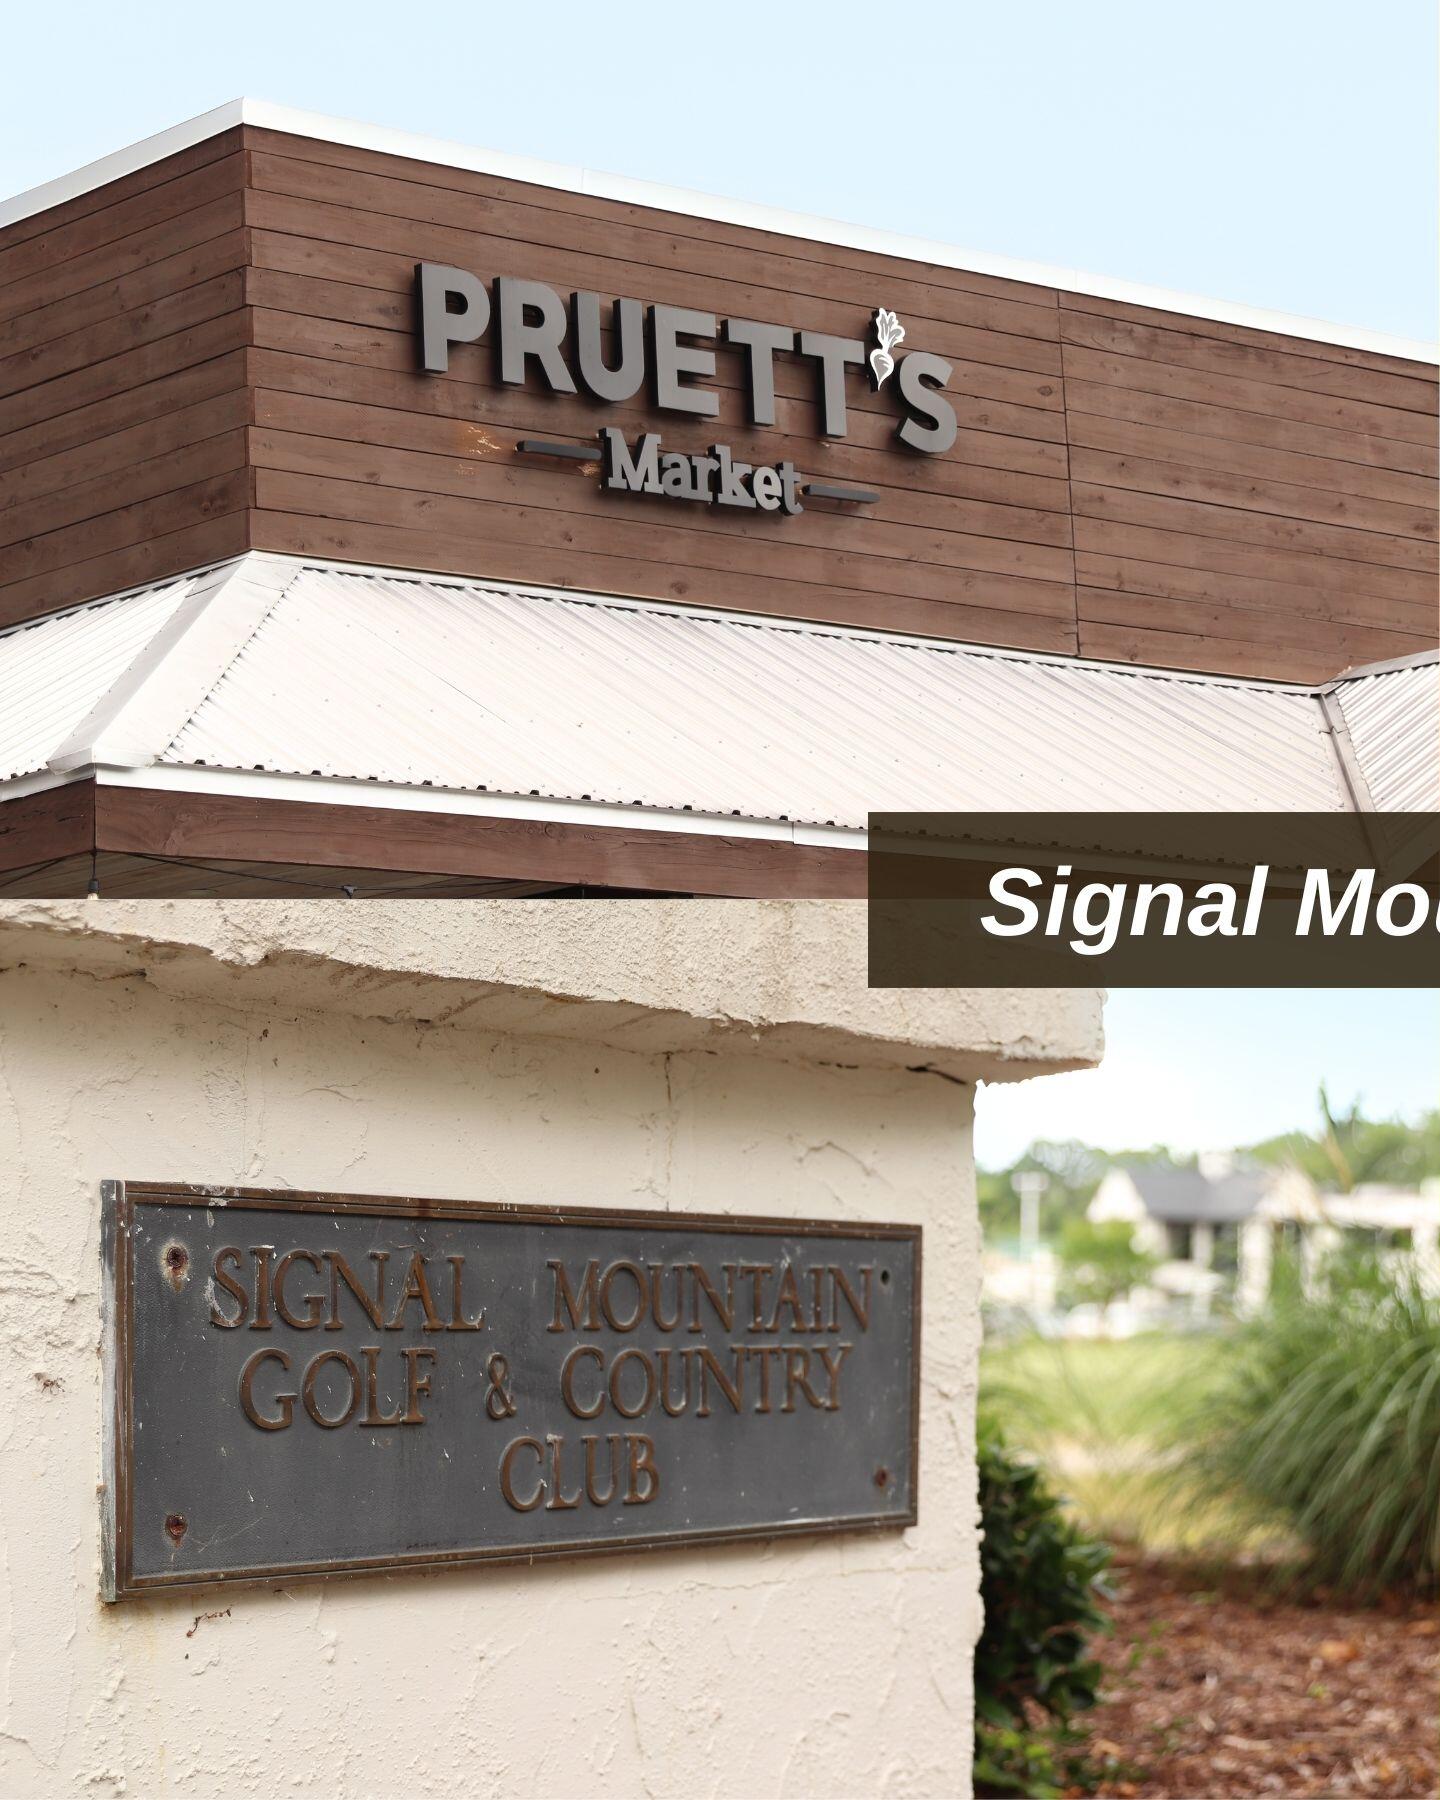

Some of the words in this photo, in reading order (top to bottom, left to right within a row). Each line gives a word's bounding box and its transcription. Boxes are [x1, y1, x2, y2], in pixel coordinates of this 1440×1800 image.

[600, 427, 803, 515] Market
[209, 1245, 486, 1332] SIGNAL
[546, 1258, 874, 1334] MOUNTAIN
[240, 1346, 437, 1431] GOLF
[485, 1352, 517, 1421] &
[560, 1342, 852, 1422] COUNTRY
[499, 1432, 660, 1512] CLUB
